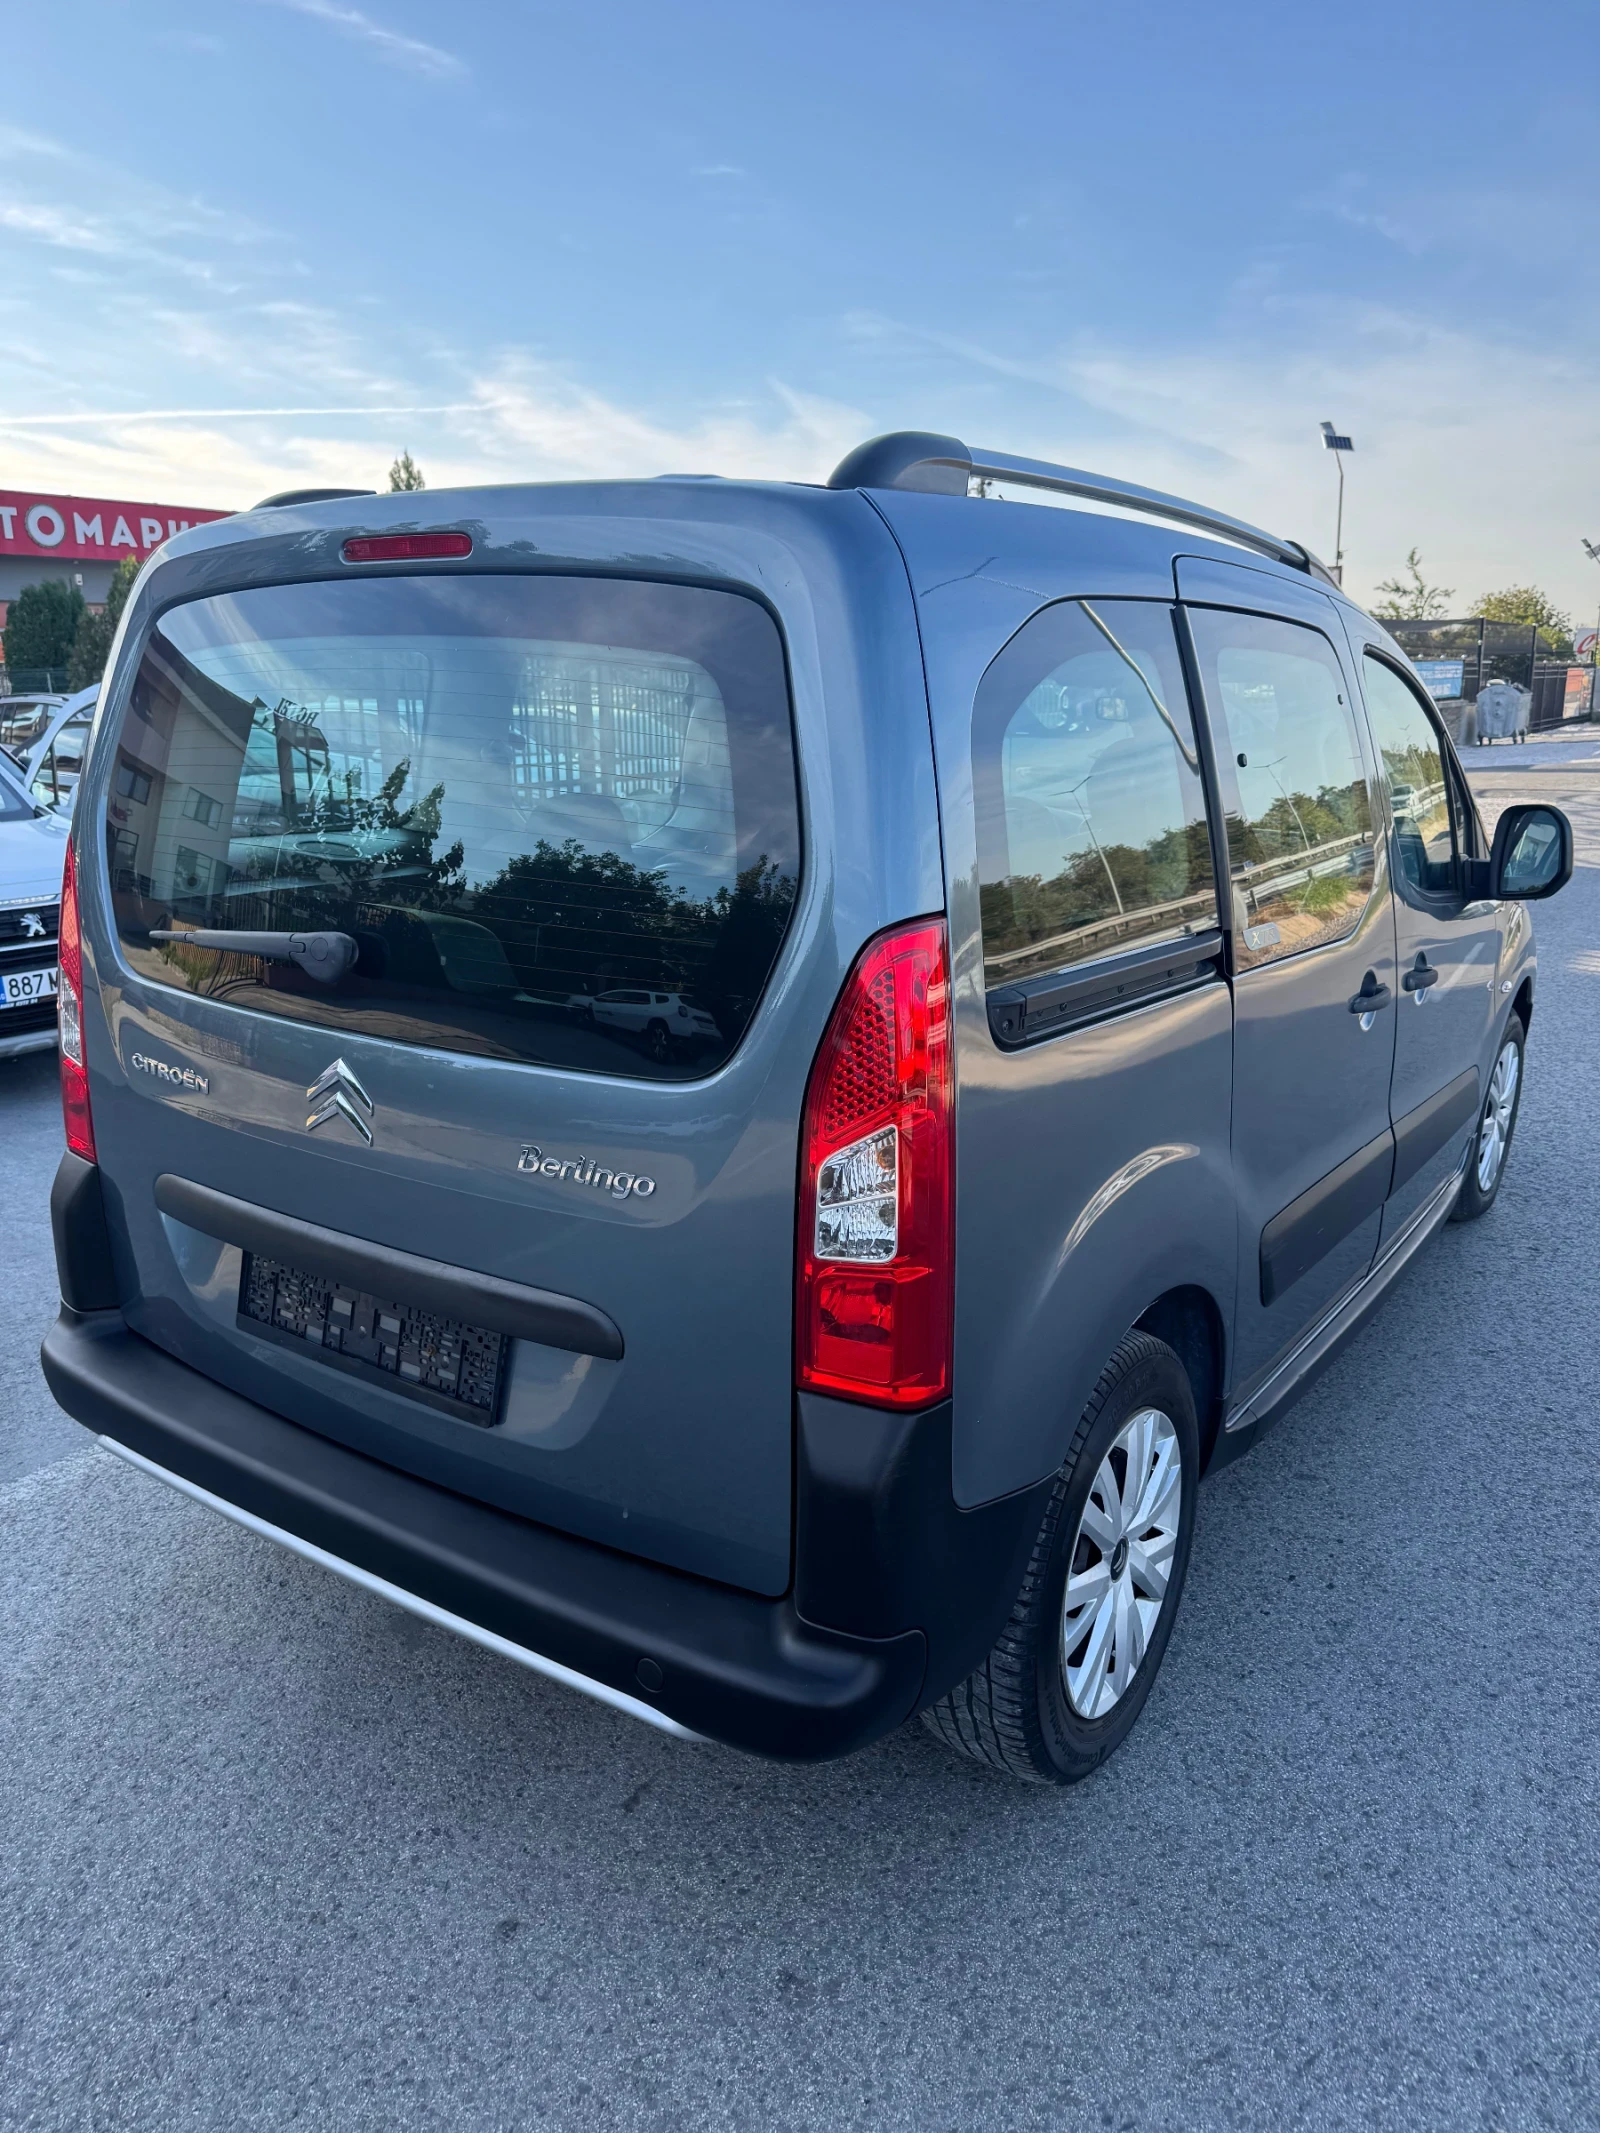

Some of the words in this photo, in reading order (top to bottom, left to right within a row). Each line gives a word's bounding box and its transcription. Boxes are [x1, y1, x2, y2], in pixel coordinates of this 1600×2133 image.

[8, 974, 43, 998] 887
[131, 1052, 210, 1095] CITROËN
[517, 1144, 656, 1199] Berlingo
